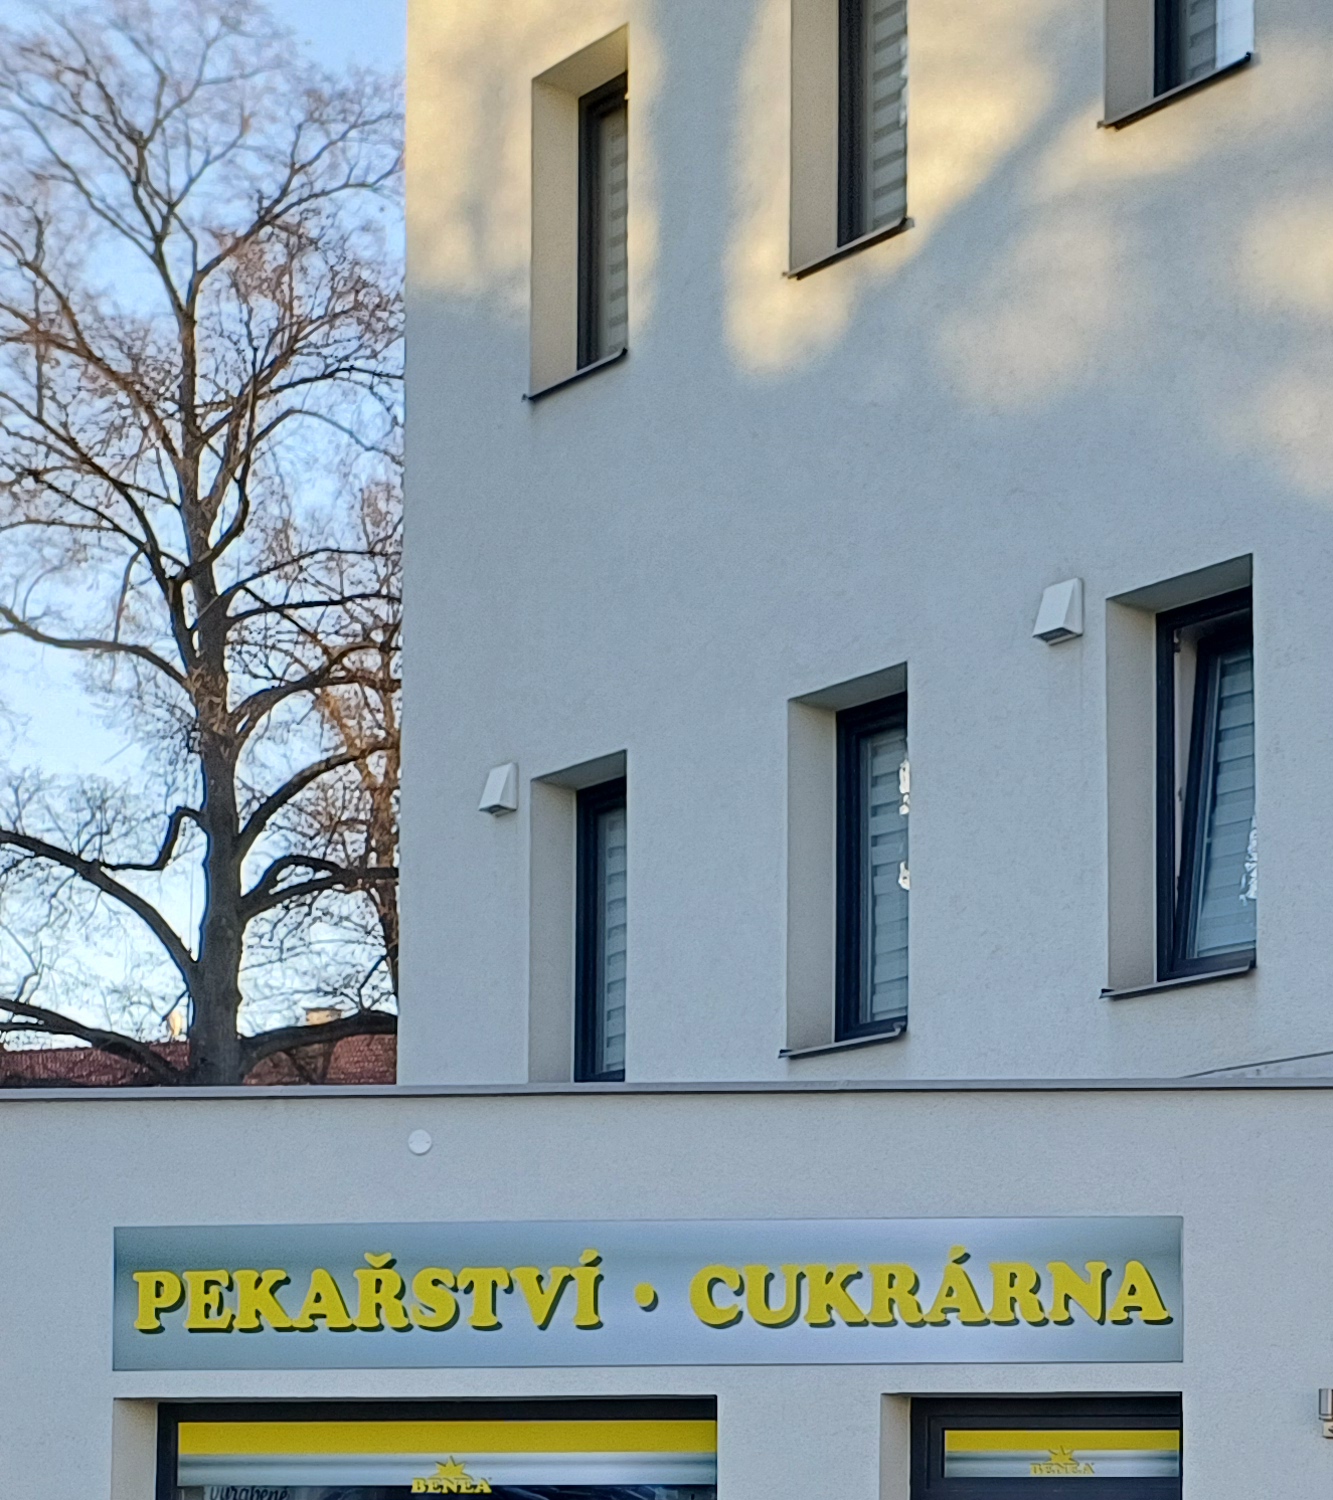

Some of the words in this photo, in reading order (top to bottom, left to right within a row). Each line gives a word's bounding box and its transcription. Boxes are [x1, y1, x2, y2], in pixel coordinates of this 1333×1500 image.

[133, 1248, 602, 1333] PEKAŘSTVÍ
[689, 1244, 1174, 1328] CUKRÁRNA
[411, 1477, 493, 1494] BENEA
